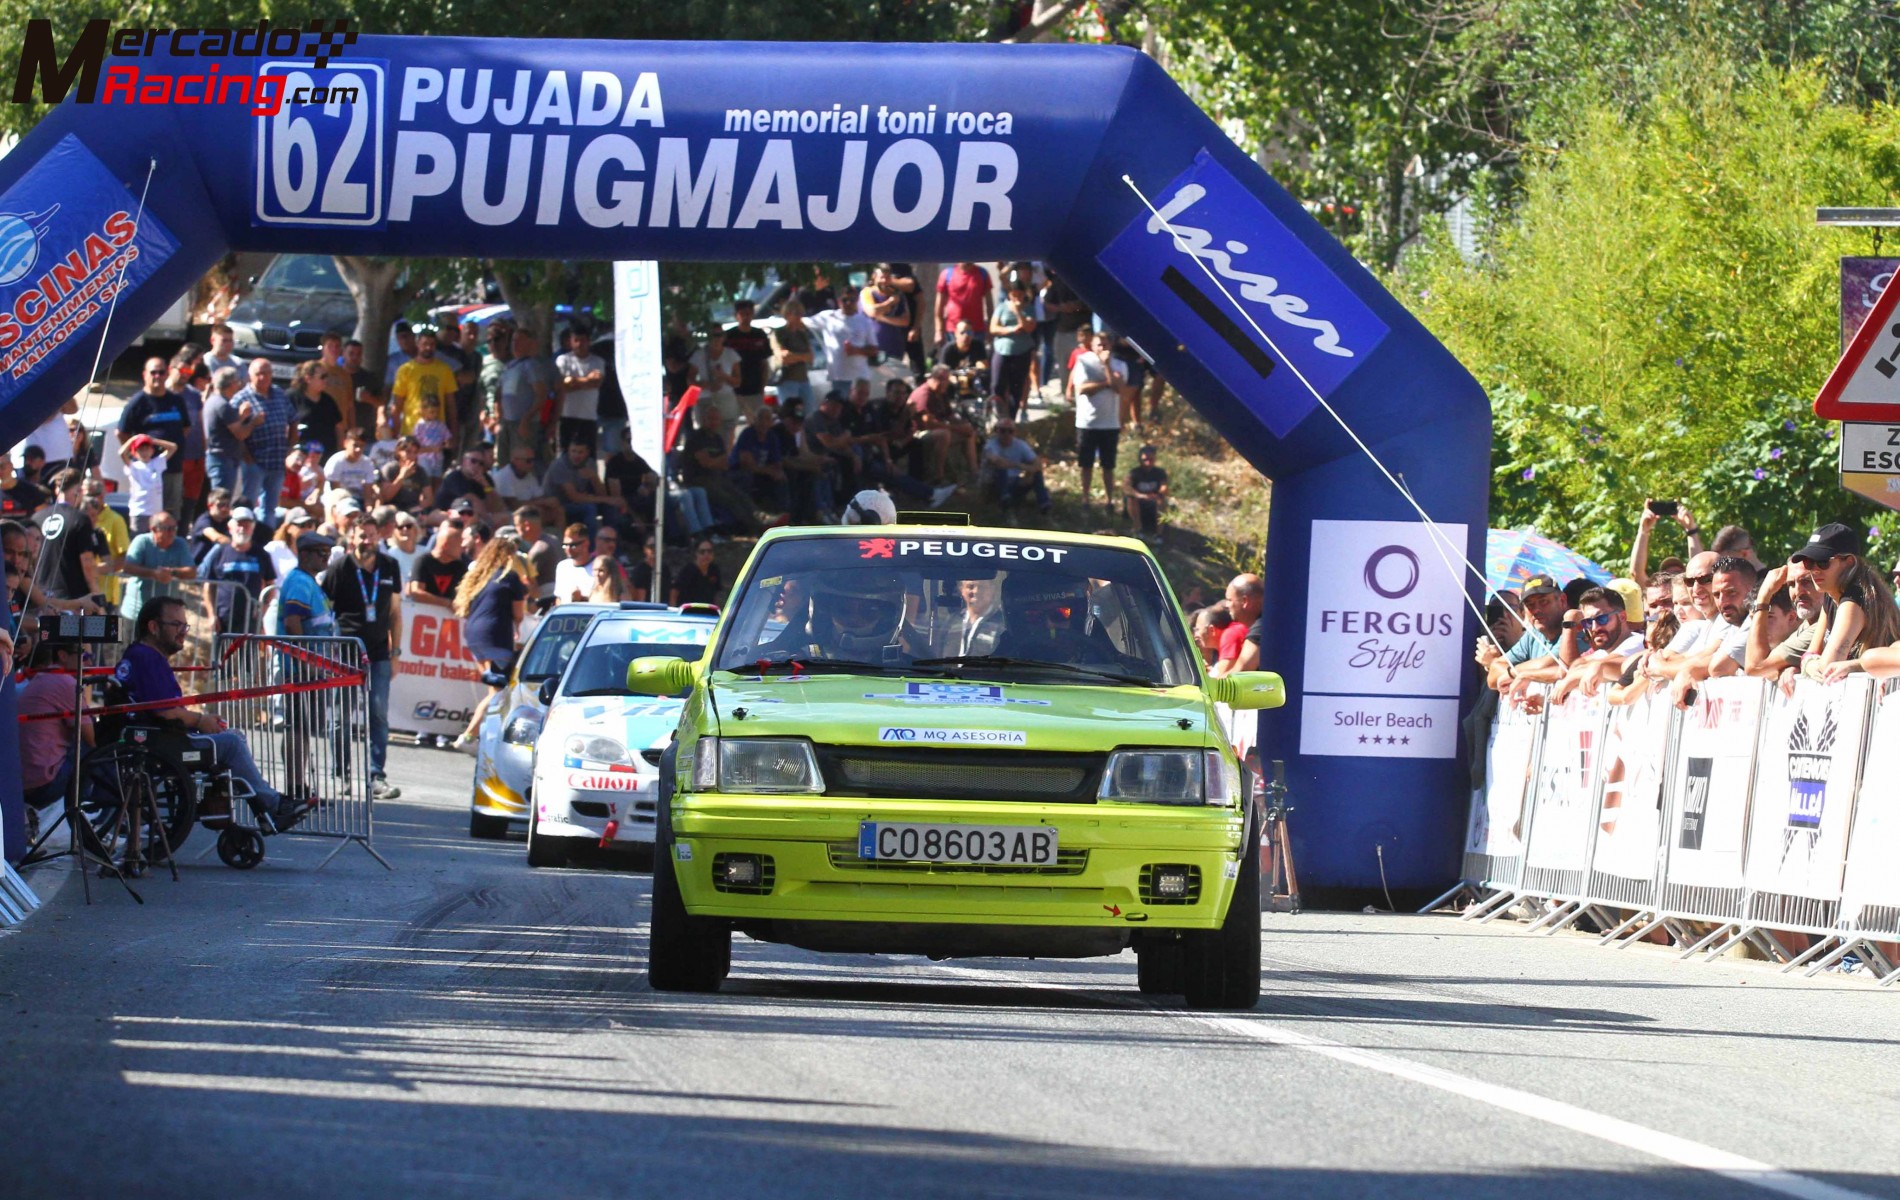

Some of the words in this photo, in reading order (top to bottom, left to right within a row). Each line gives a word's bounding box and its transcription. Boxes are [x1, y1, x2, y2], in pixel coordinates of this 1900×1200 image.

[400, 67, 664, 127] PUJADA
[724, 103, 869, 133] memorial
[878, 105, 936, 134] toni
[945, 111, 1013, 135] roca
[272, 71, 369, 214] 62
[388, 131, 1019, 232] PUIGMAJOR
[0, 245, 139, 373] MANTENIMIENTOS
[12, 301, 101, 380] MALLORCA
[900, 541, 1067, 563] PEUGEOT
[1321, 610, 1453, 636] FERGUS
[399, 660, 438, 677] motor
[1349, 638, 1426, 683] Style
[1334, 711, 1382, 727] Soller
[1386, 712, 1433, 729] Beach
[924, 731, 947, 741] MQ
[952, 731, 1023, 742] ASESORÍA
[568, 774, 638, 791] Canon
